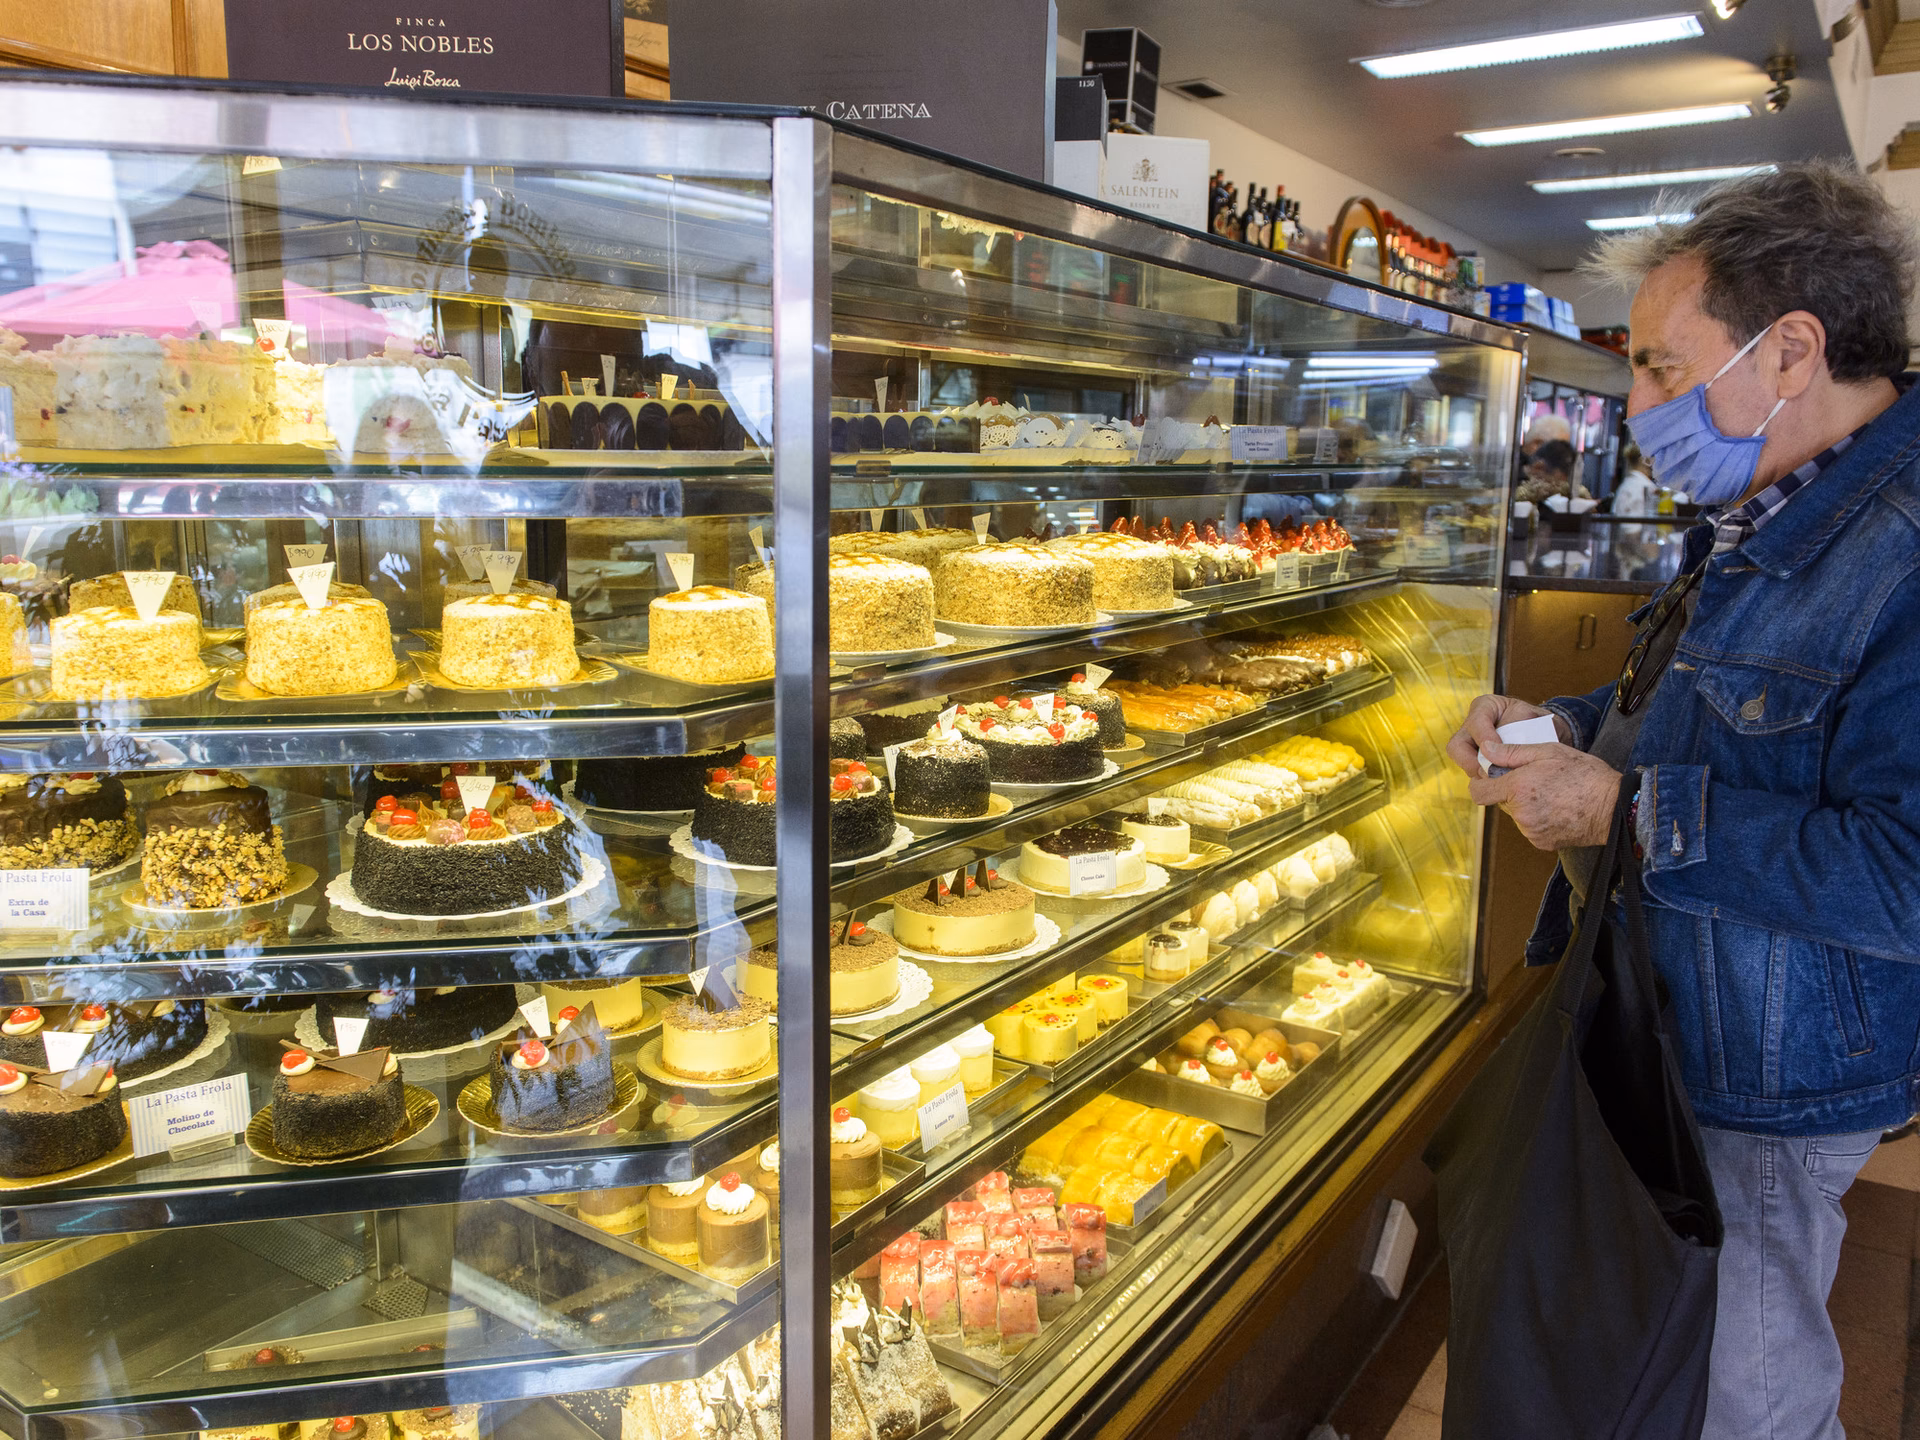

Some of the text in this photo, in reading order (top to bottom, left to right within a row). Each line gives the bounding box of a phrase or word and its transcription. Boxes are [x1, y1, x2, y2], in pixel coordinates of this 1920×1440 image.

[395, 17, 446, 27] FINCA
[347, 33, 494, 54] LOS NOBLES
[384, 67, 461, 90] Luigi Bosca
[1111, 185, 1179, 198] SALENTEIN
[1075, 854, 1110, 865] La Pasta Frola
[6, 872, 72, 883] Pasta Frola
[8, 898, 49, 906] Extra de
[23, 908, 46, 916] Casa
[145, 1081, 232, 1108] La Pasta Frola
[924, 1088, 959, 1114] La Pasta Frola
[167, 1108, 215, 1126] Molino de
[168, 1118, 216, 1135] Chocolate
